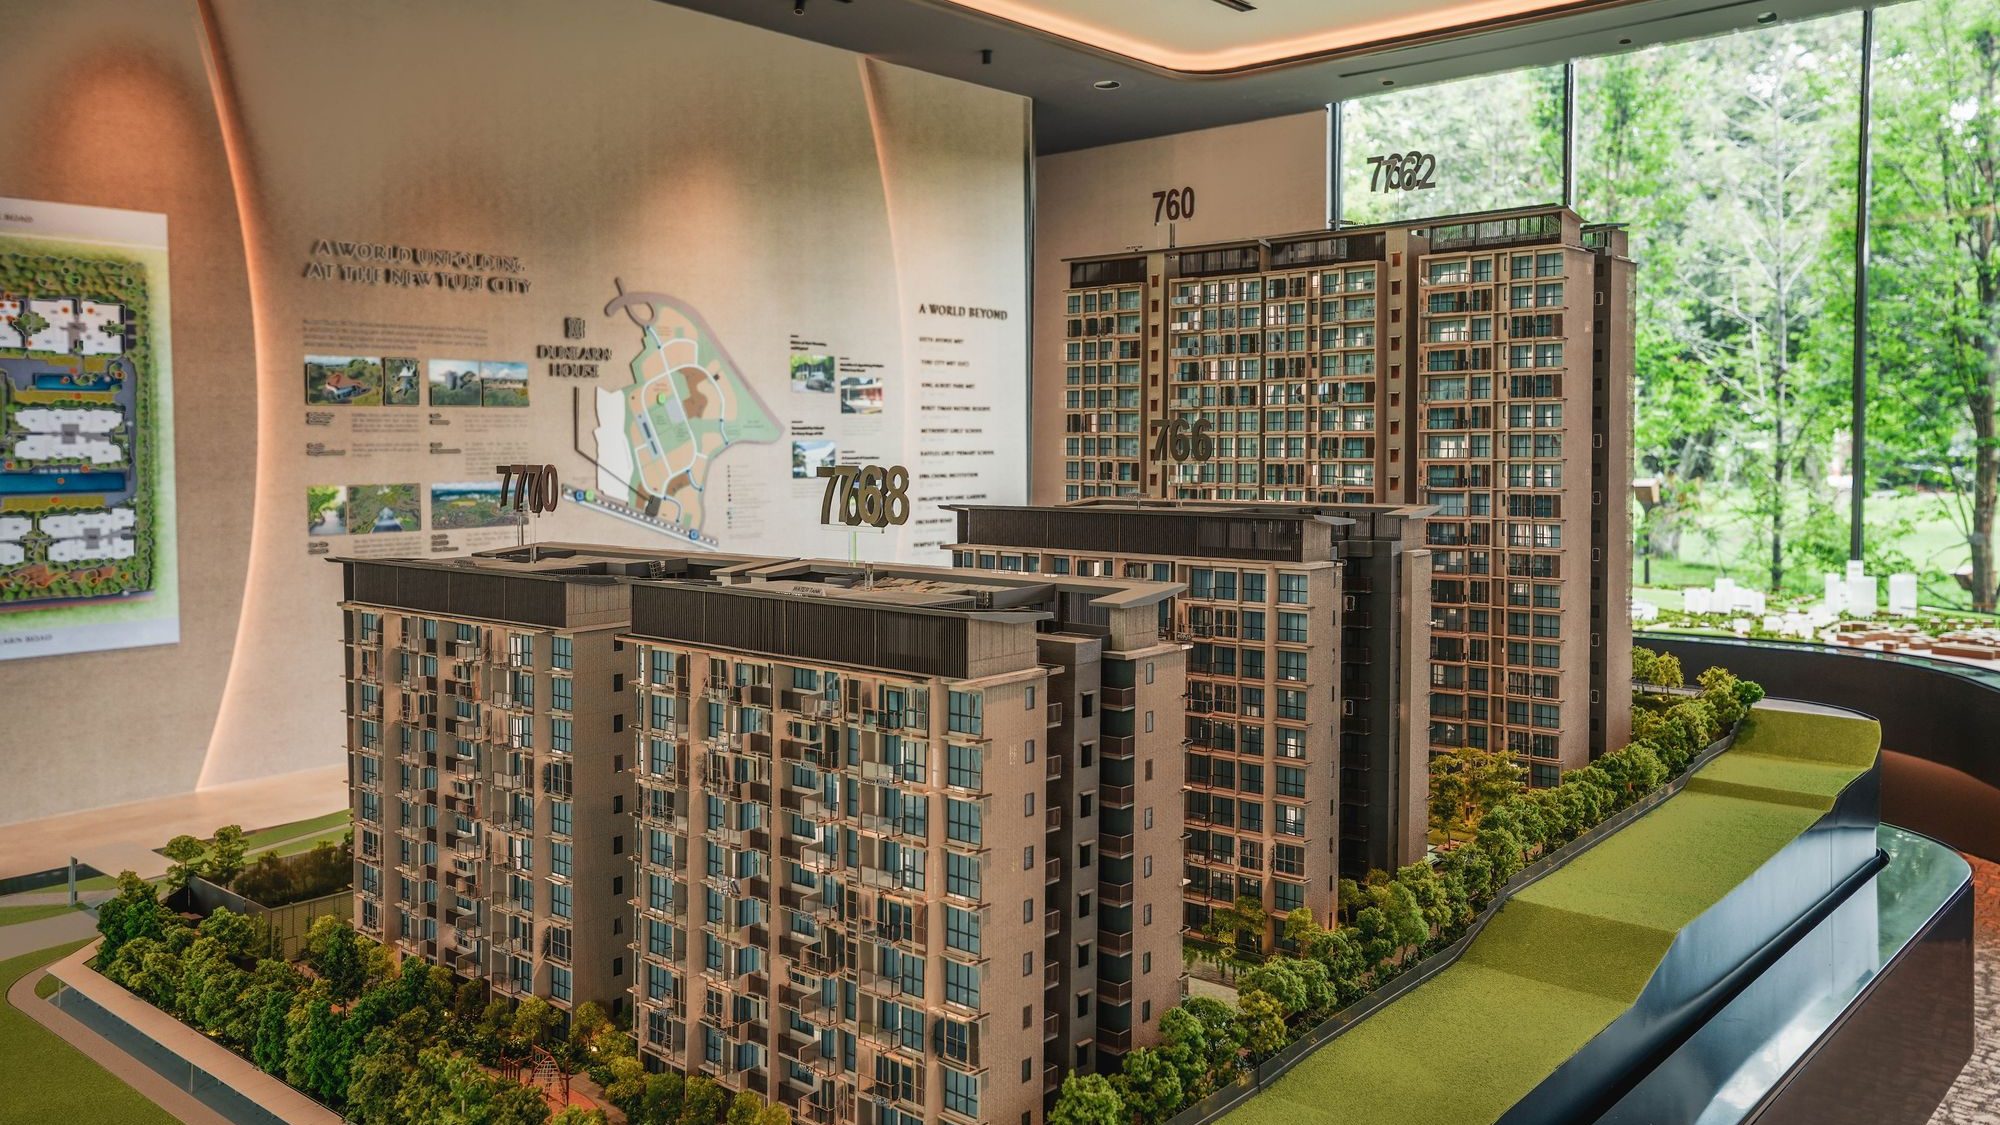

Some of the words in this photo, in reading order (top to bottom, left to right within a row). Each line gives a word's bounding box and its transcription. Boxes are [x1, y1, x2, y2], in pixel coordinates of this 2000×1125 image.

[1152, 186, 1195, 223] 760
[337, 242, 414, 264] WORLD
[340, 264, 382, 284] THE
[385, 268, 431, 289] NEW
[919, 304, 926, 314] A
[929, 304, 966, 318] WORLD
[969, 307, 1008, 320] BEYOND
[1151, 418, 1213, 463] 766
